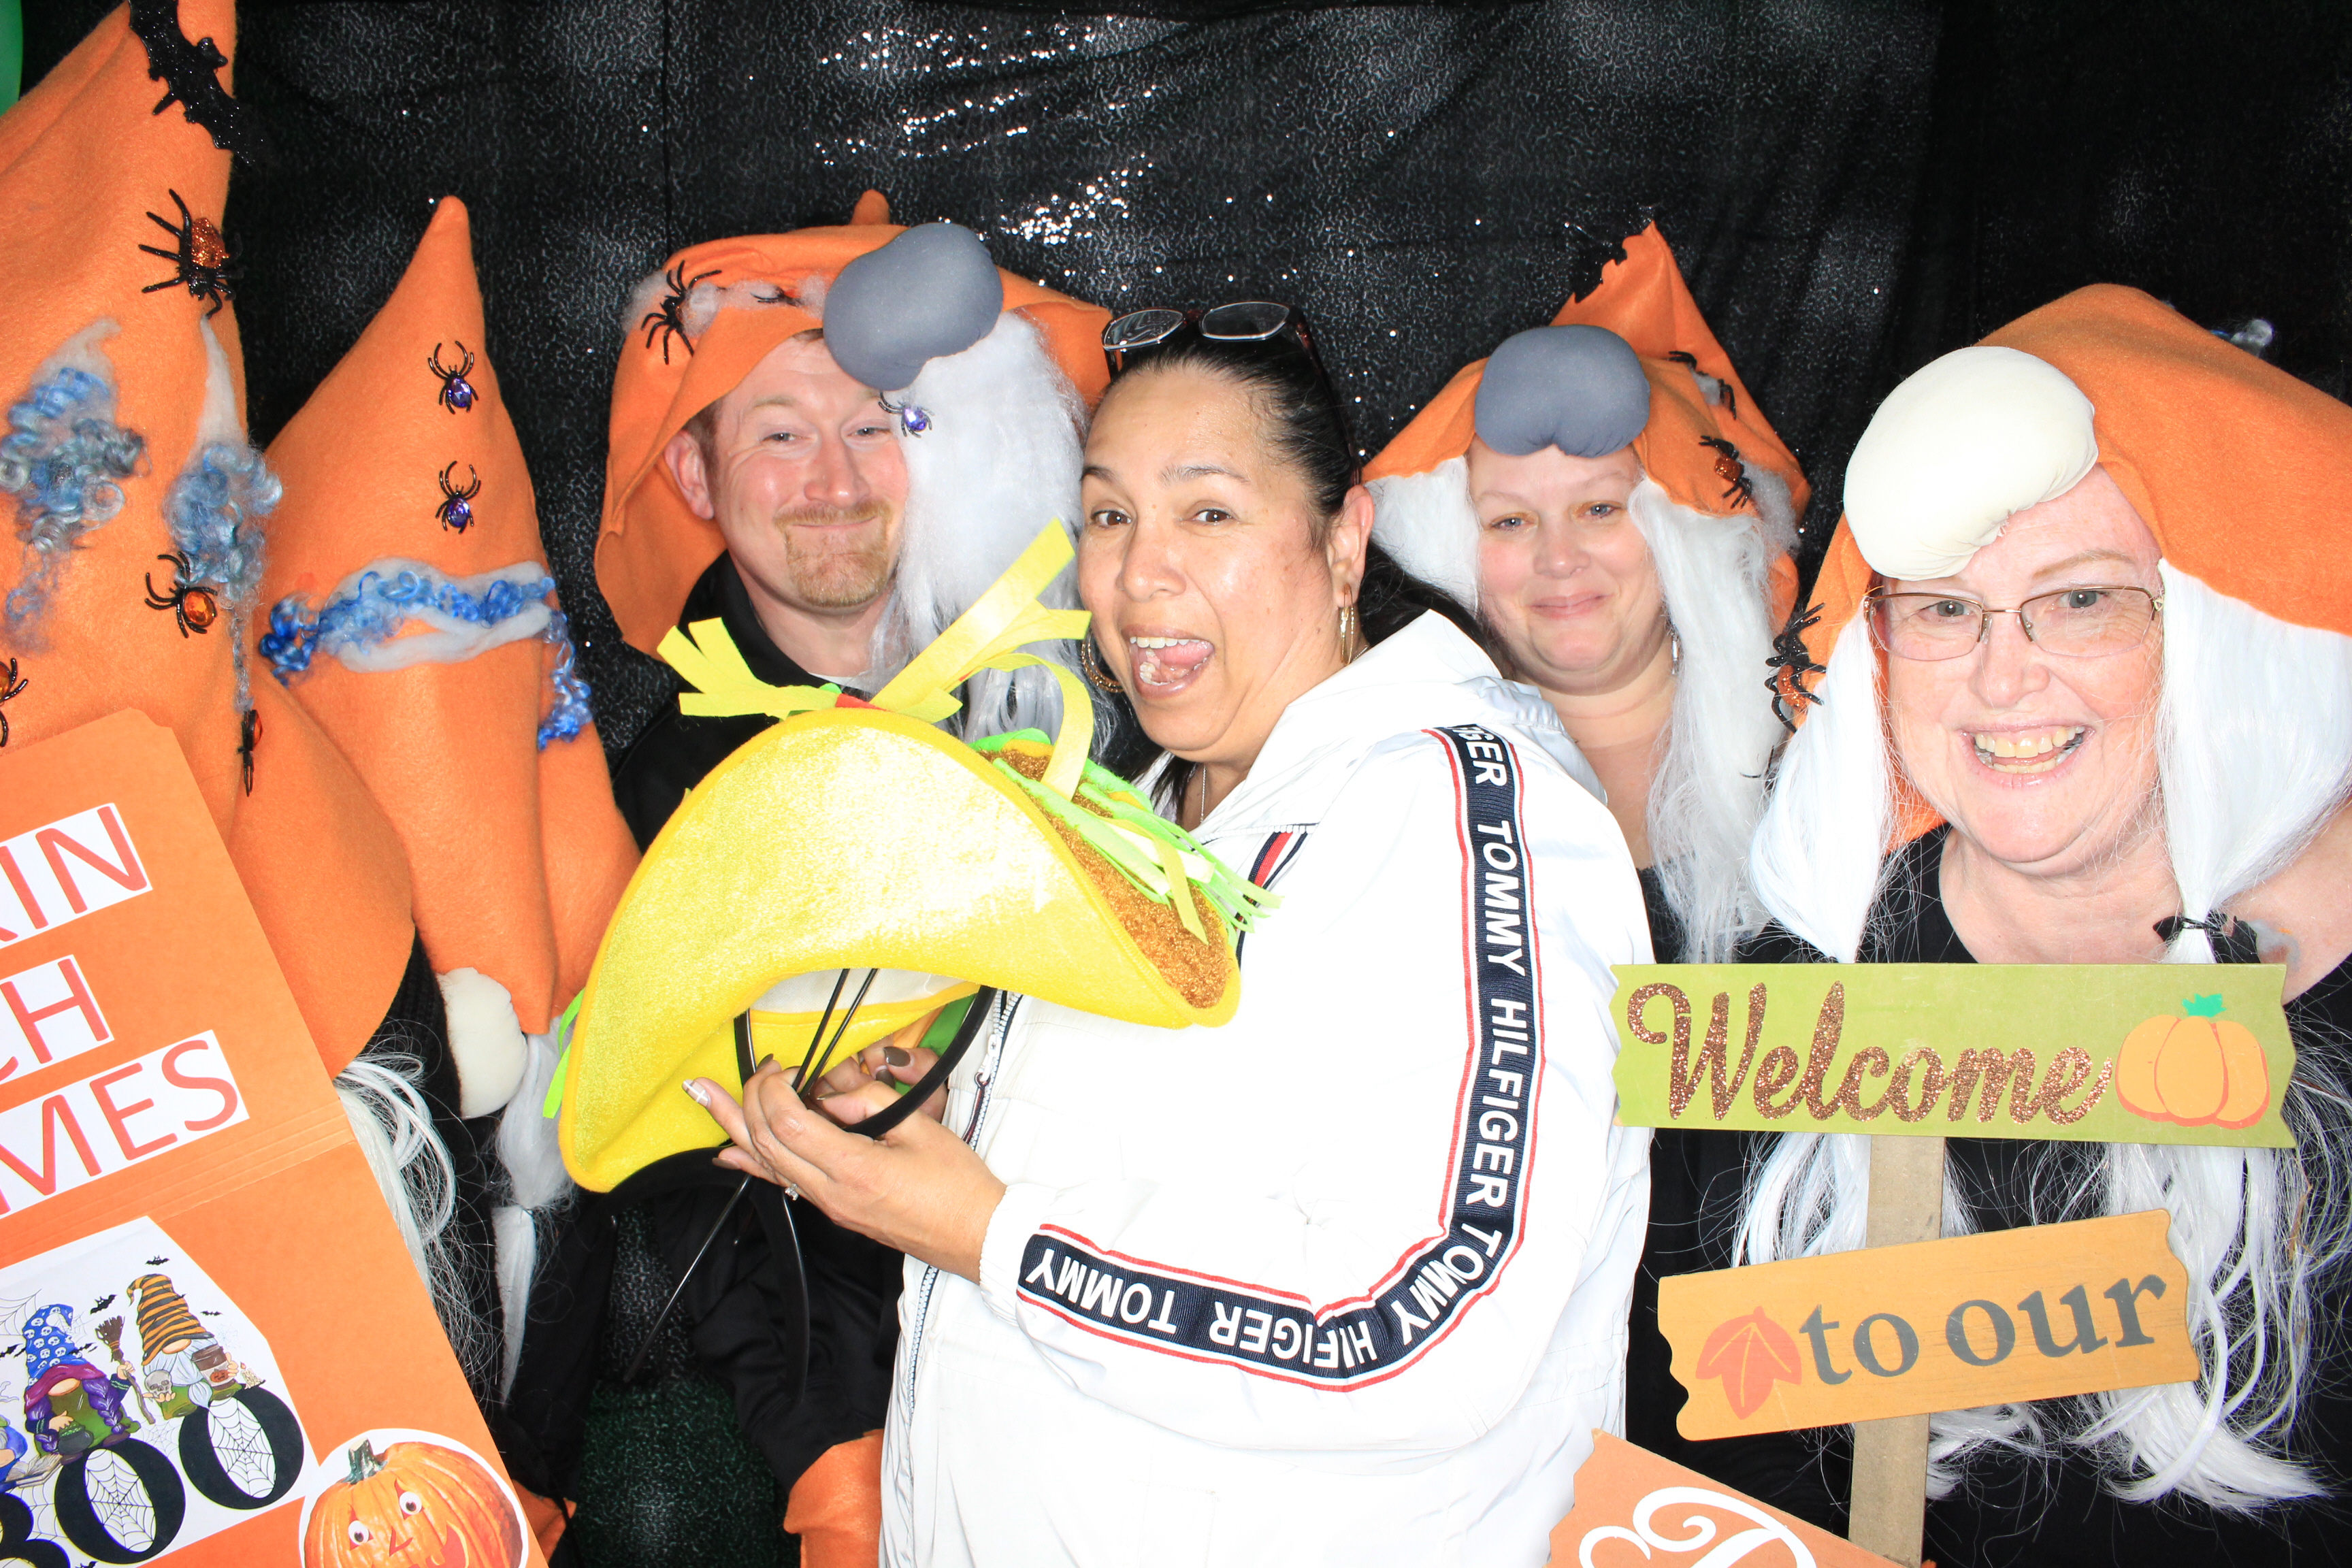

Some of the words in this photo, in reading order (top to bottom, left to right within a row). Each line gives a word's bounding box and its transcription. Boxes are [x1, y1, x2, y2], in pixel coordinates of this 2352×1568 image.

[0, 806, 147, 942] IN
[1477, 820, 1526, 976] TOMMY
[0, 960, 109, 1081] H
[1627, 981, 2113, 1124] Welcome
[1466, 998, 1529, 1208] HILFIGER
[1026, 1248, 1176, 1335] TOMMY
[1390, 1223, 1503, 1346] TOMMY
[1799, 1304, 1920, 1386] to
[1945, 1274, 2167, 1366] our
